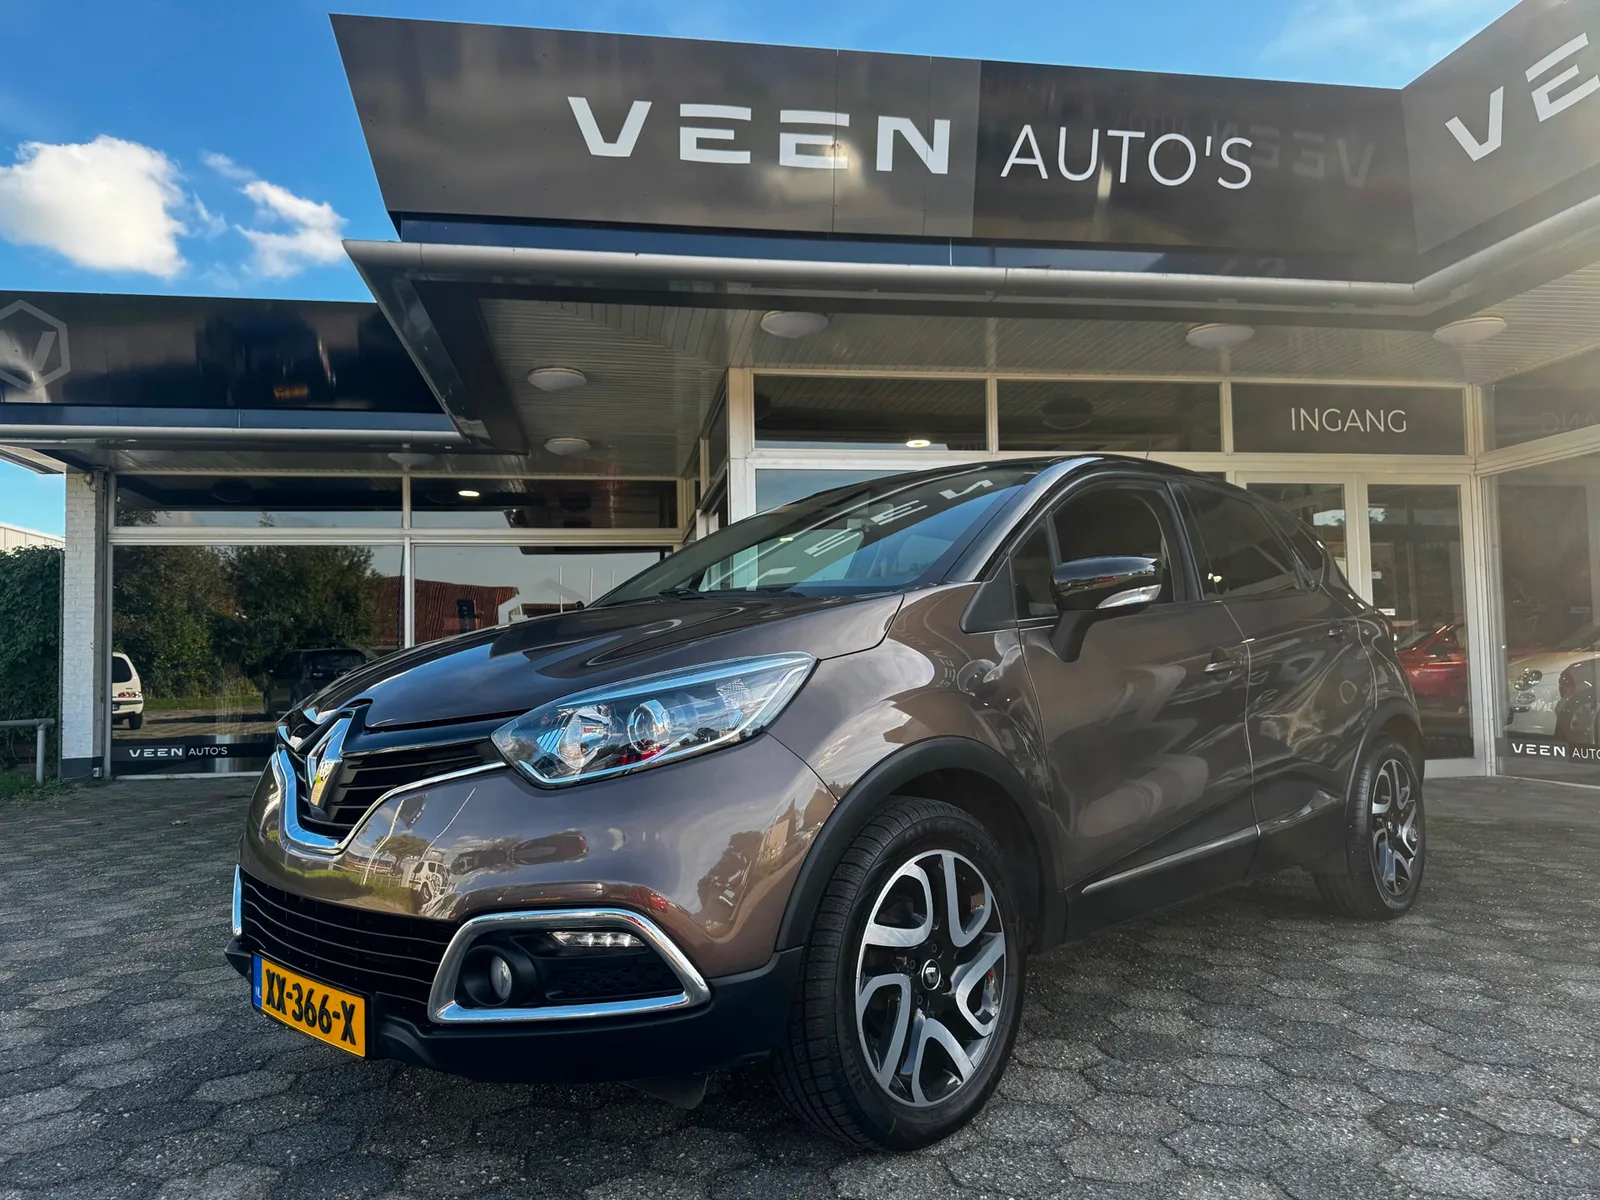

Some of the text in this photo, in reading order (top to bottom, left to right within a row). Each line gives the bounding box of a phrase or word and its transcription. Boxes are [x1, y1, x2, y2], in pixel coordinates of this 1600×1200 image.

[567, 96, 1252, 190] VEEN AUTO'S
[1291, 407, 1407, 433] INGANG
[128, 746, 228, 758] VEEN AUTO'S
[1511, 742, 1567, 758] VEEN
[265, 969, 356, 1045] XX-366-X
